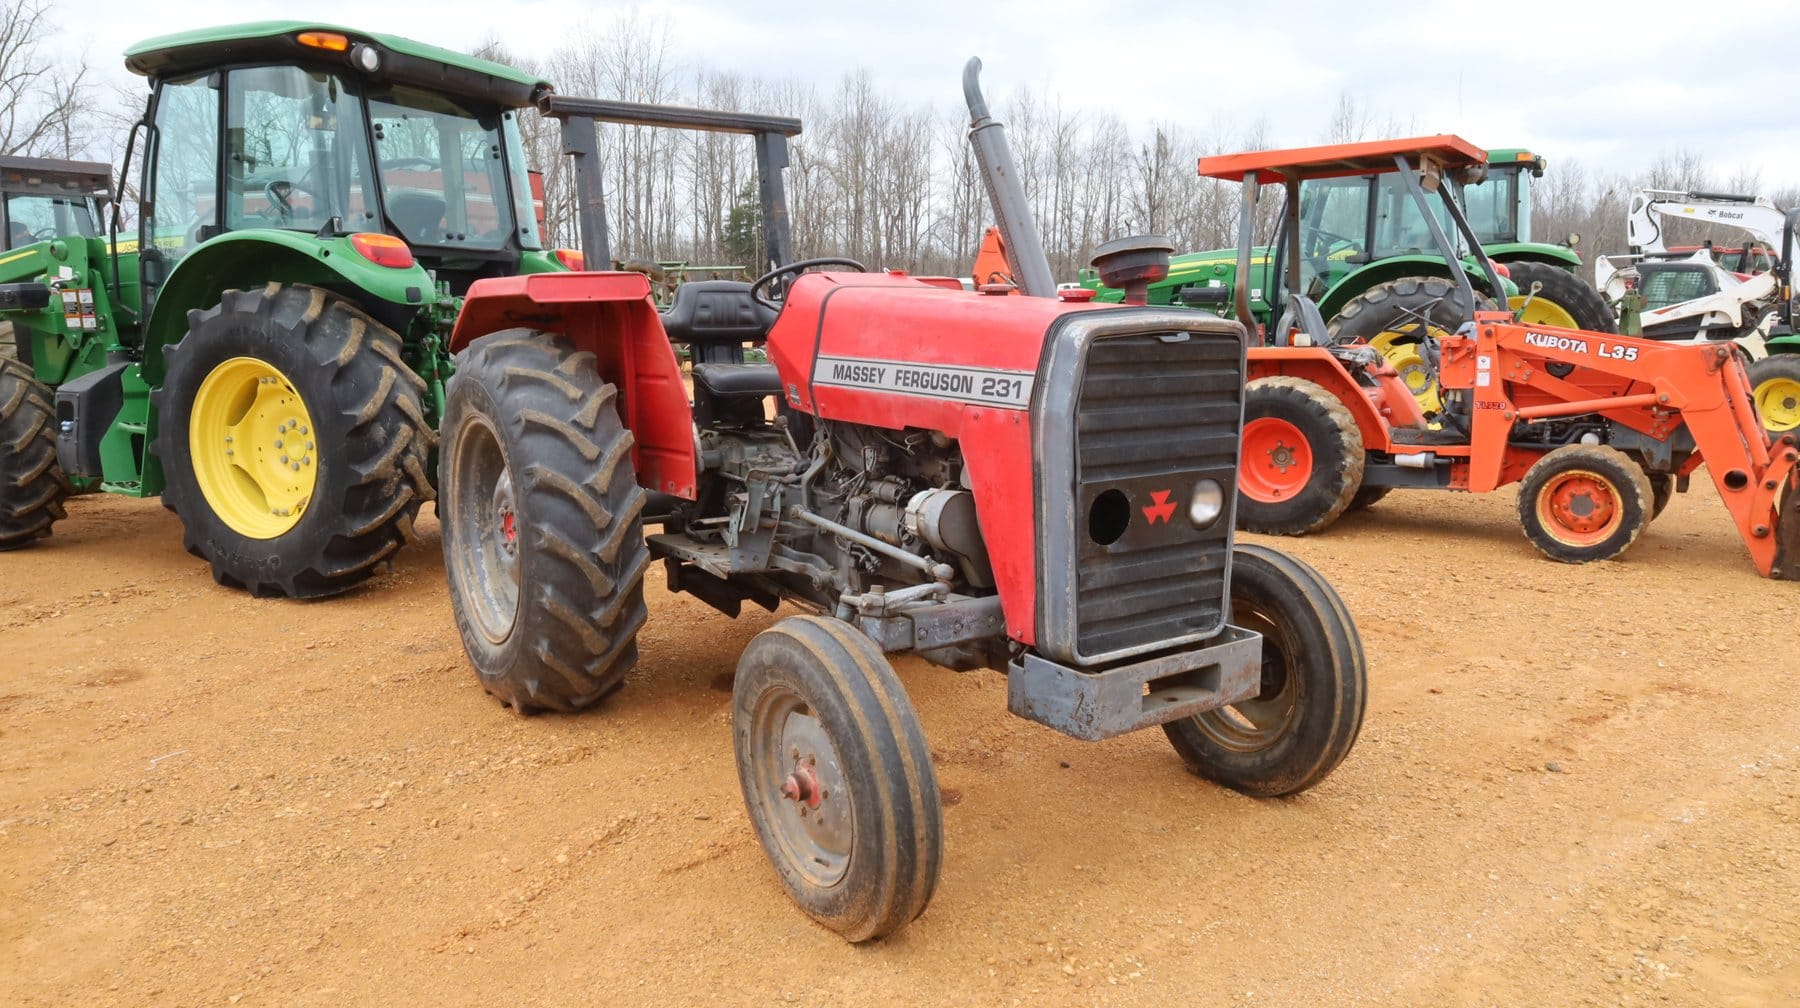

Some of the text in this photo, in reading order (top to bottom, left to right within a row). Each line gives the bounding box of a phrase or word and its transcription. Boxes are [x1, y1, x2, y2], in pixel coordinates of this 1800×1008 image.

[1719, 210, 1744, 220] Bobcat
[1525, 332, 1639, 361] KUBOTA L35
[832, 363, 1023, 400] MASSEY FERGUSON 231
